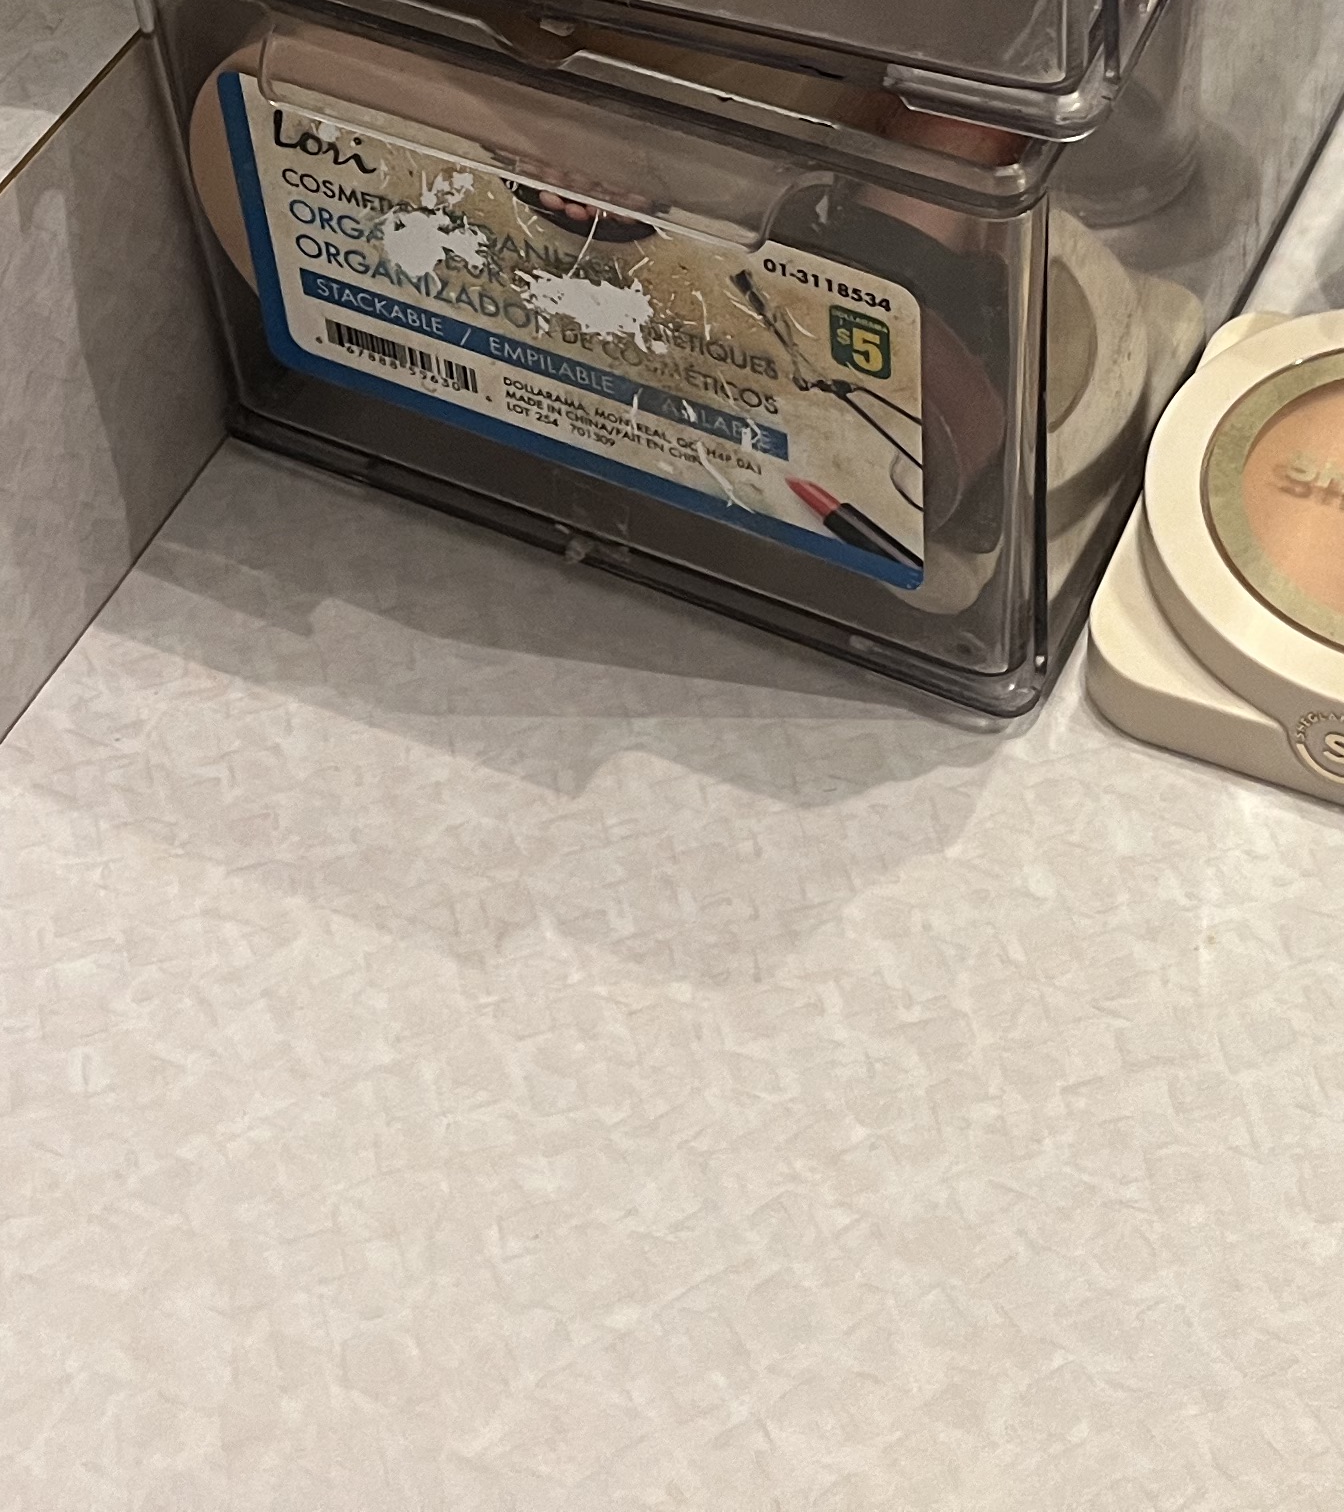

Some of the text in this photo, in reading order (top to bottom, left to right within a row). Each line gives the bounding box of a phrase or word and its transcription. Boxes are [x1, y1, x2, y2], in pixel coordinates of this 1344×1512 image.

[763, 258, 892, 313] 01-3118534
[316, 278, 445, 338] STACKABLE
[489, 336, 615, 395] EMPILABLE
[836, 327, 884, 373] $5
[506, 401, 531, 418] LOT
[506, 390, 544, 415] MADE
[547, 403, 563, 418] IN
[668, 446, 708, 468] CHIN
